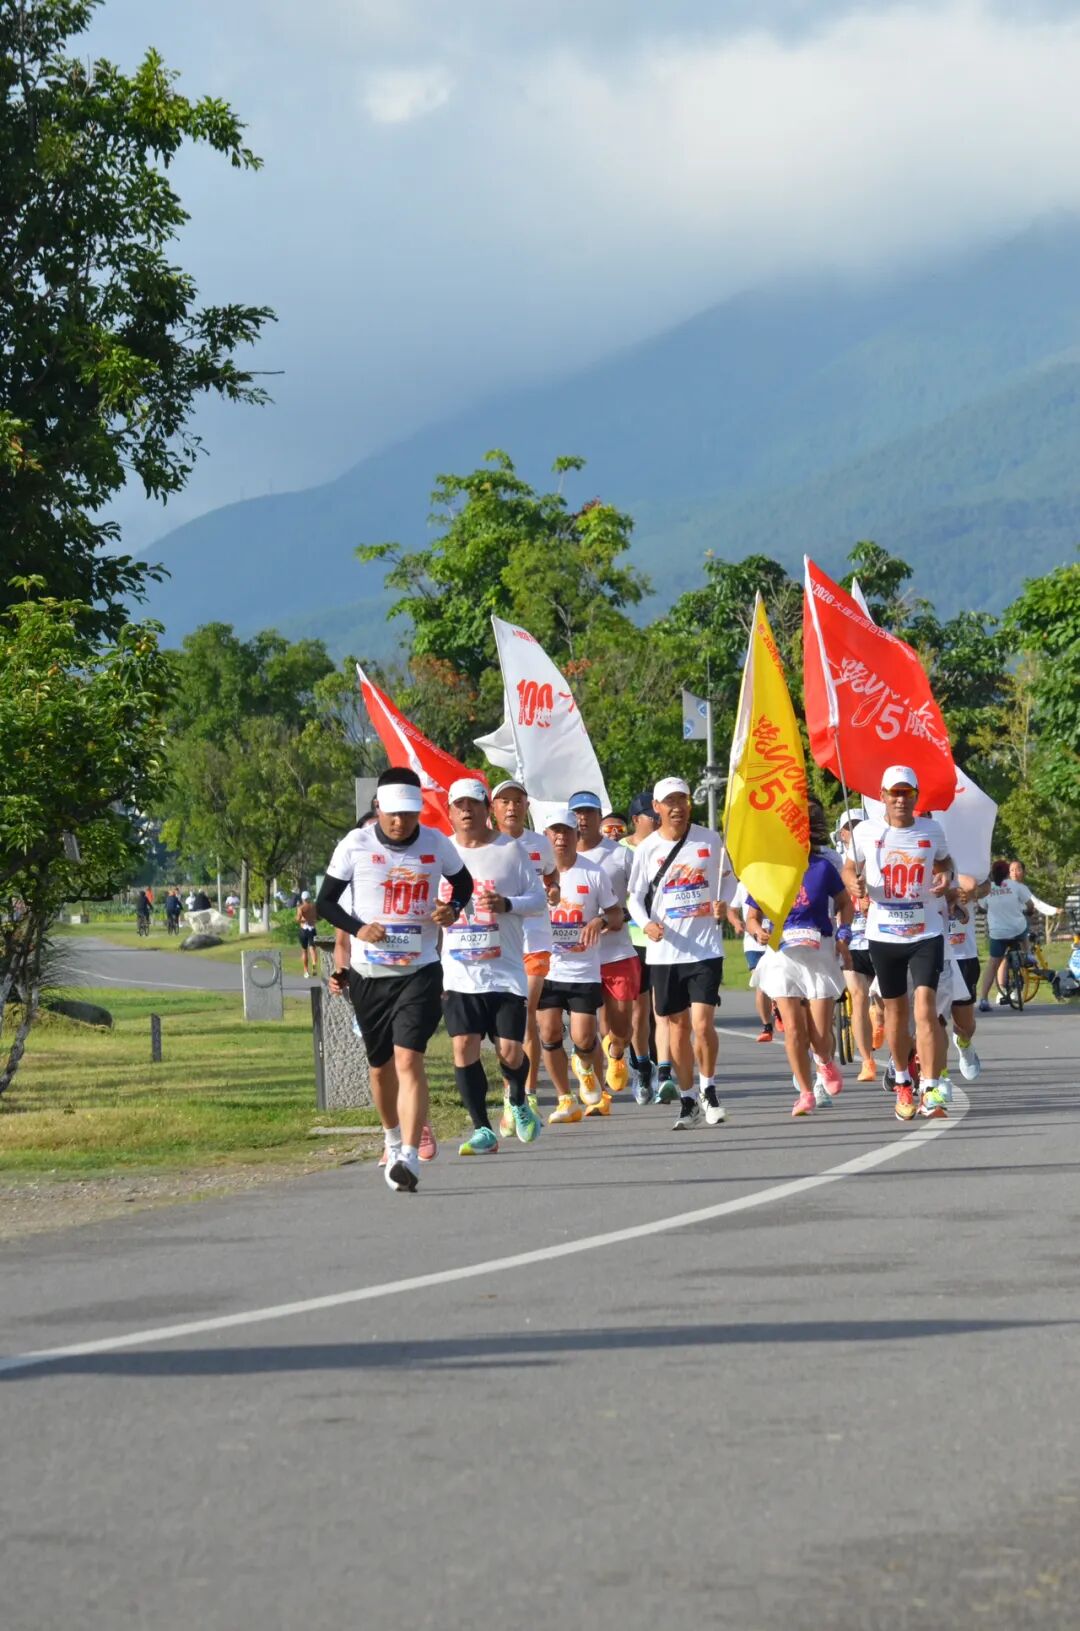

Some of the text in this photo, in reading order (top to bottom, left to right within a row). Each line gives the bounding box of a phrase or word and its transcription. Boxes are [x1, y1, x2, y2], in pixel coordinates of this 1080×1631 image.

[813, 583, 835, 604] 2026
[882, 863, 925, 899] 100
[380, 879, 429, 915] 100
[888, 911, 914, 919] A0152
[460, 933, 488, 943] A0277
[552, 929, 579, 937] A0249
[383, 935, 410, 944] 0268
